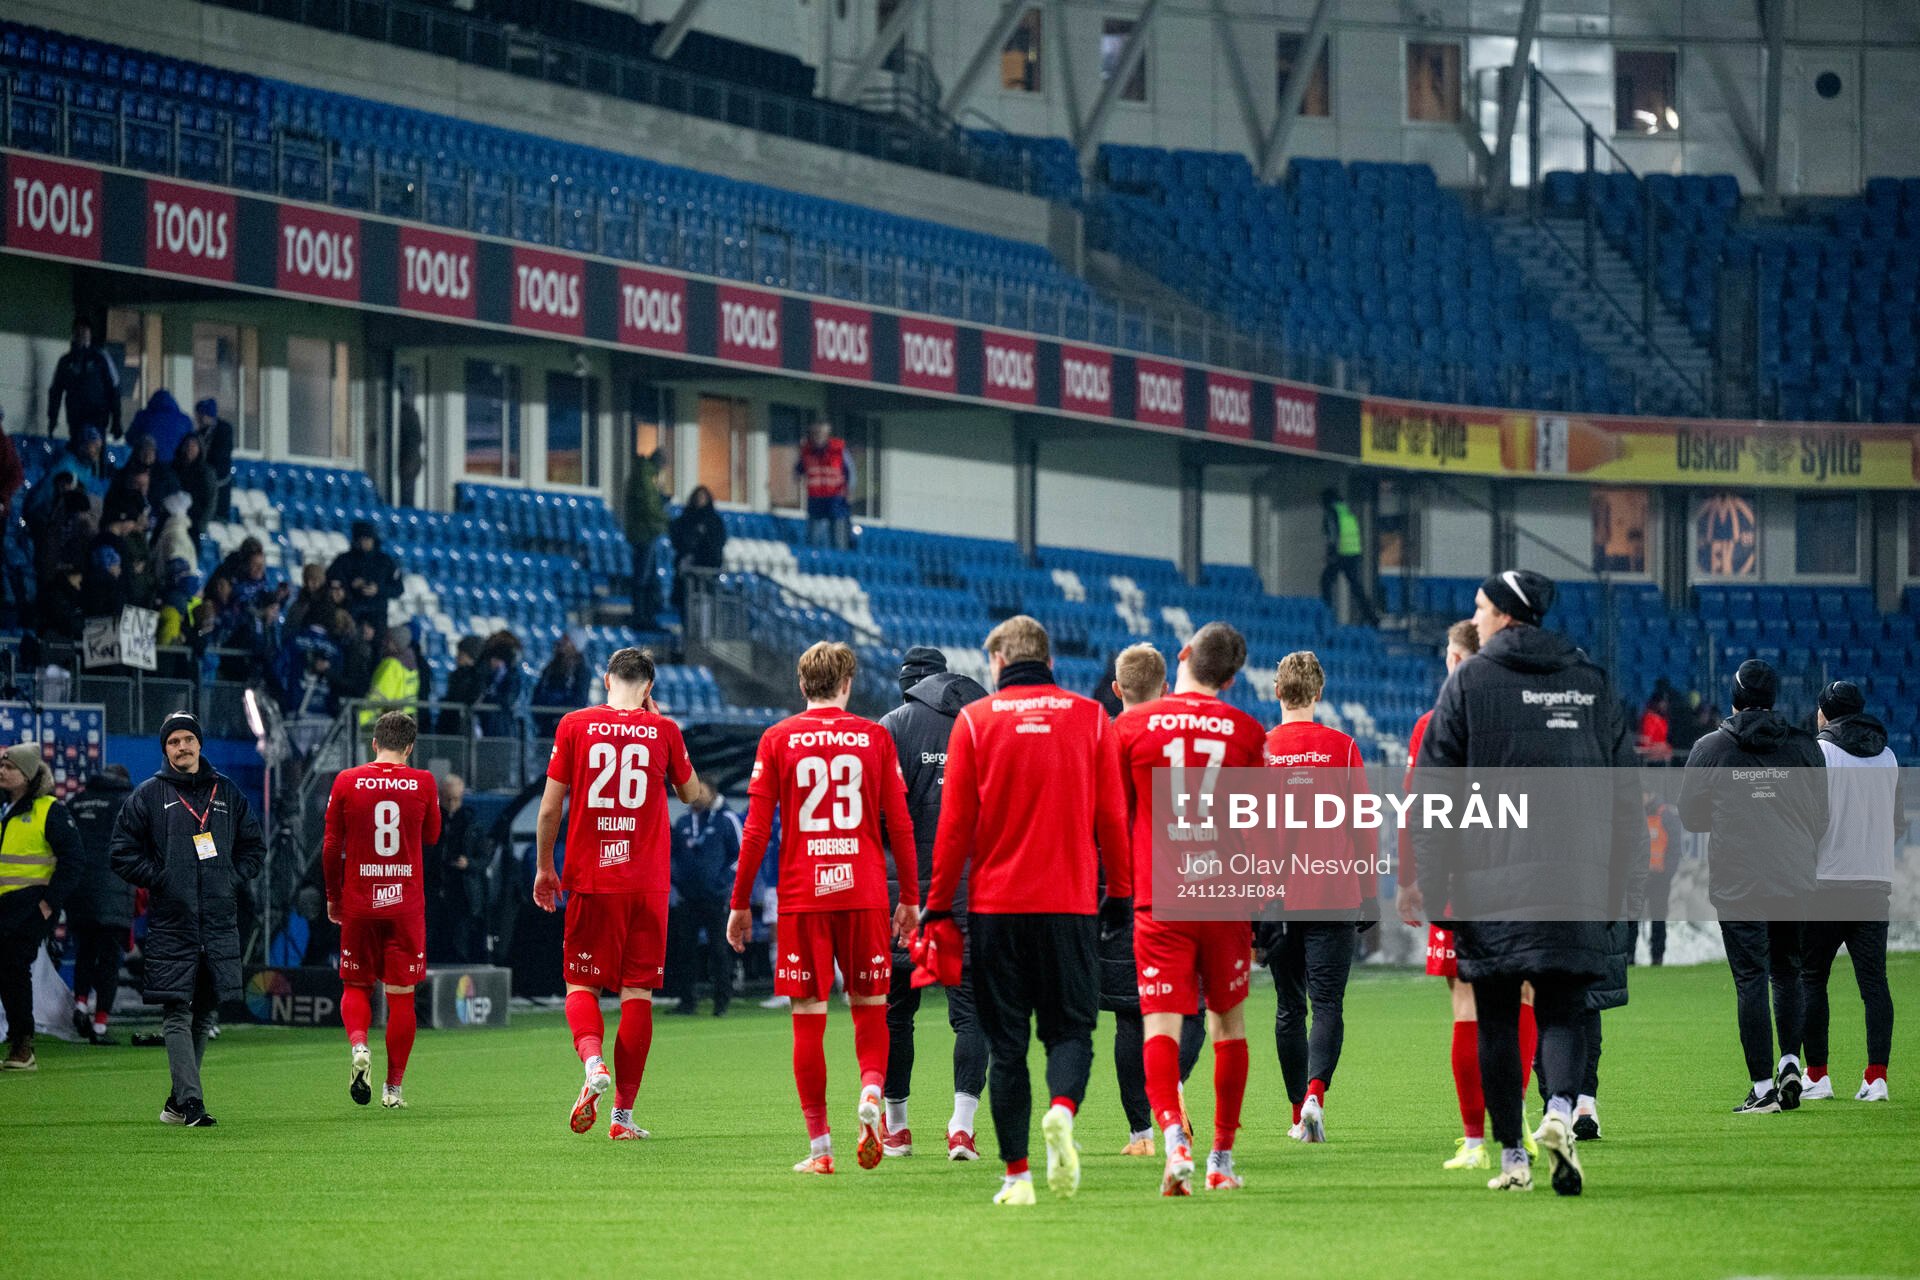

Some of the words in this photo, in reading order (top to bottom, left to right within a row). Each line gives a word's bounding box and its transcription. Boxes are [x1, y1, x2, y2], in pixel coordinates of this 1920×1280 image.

[14, 177, 94, 238] TOOLS
[153, 201, 228, 260] TOOLS
[283, 225, 354, 281] TOOLS
[404, 246, 470, 300] TOOLS
[516, 265, 579, 318] TOOLS
[622, 285, 682, 335] TOOLS
[720, 302, 778, 351] TOOLS
[814, 319, 868, 365] TOOLS
[903, 332, 953, 378] TOOLS
[985, 346, 1034, 390] TOOLS
[1063, 359, 1111, 401] TOOLS
[1139, 371, 1183, 414] TOOLS
[1209, 385, 1250, 426] TOOLS
[1276, 397, 1316, 437] TOOLS
[1677, 425, 1745, 471] Oskar
[1801, 430, 1862, 482] Sylte
[992, 696, 1073, 712] BergenFiber
[1522, 690, 1596, 706] BergenFiber
[587, 722, 658, 739] FOTMOB
[788, 730, 870, 749] FOTMOB
[1147, 713, 1235, 736] FOTMOB
[355, 778, 418, 791] FOTMOB
[588, 742, 650, 809] 26
[796, 754, 863, 833] 23
[1732, 768, 1790, 781] BergenFiber
[374, 800, 400, 857] 8
[597, 817, 636, 831] HELLAND
[604, 840, 630, 859] MOT
[807, 838, 859, 856] PEDERSEN
[360, 864, 384, 876] HORN
[385, 864, 412, 877] MYHRE
[820, 864, 851, 886] MOT
[271, 996, 334, 1023] NEP
[465, 996, 492, 1024] NEP
